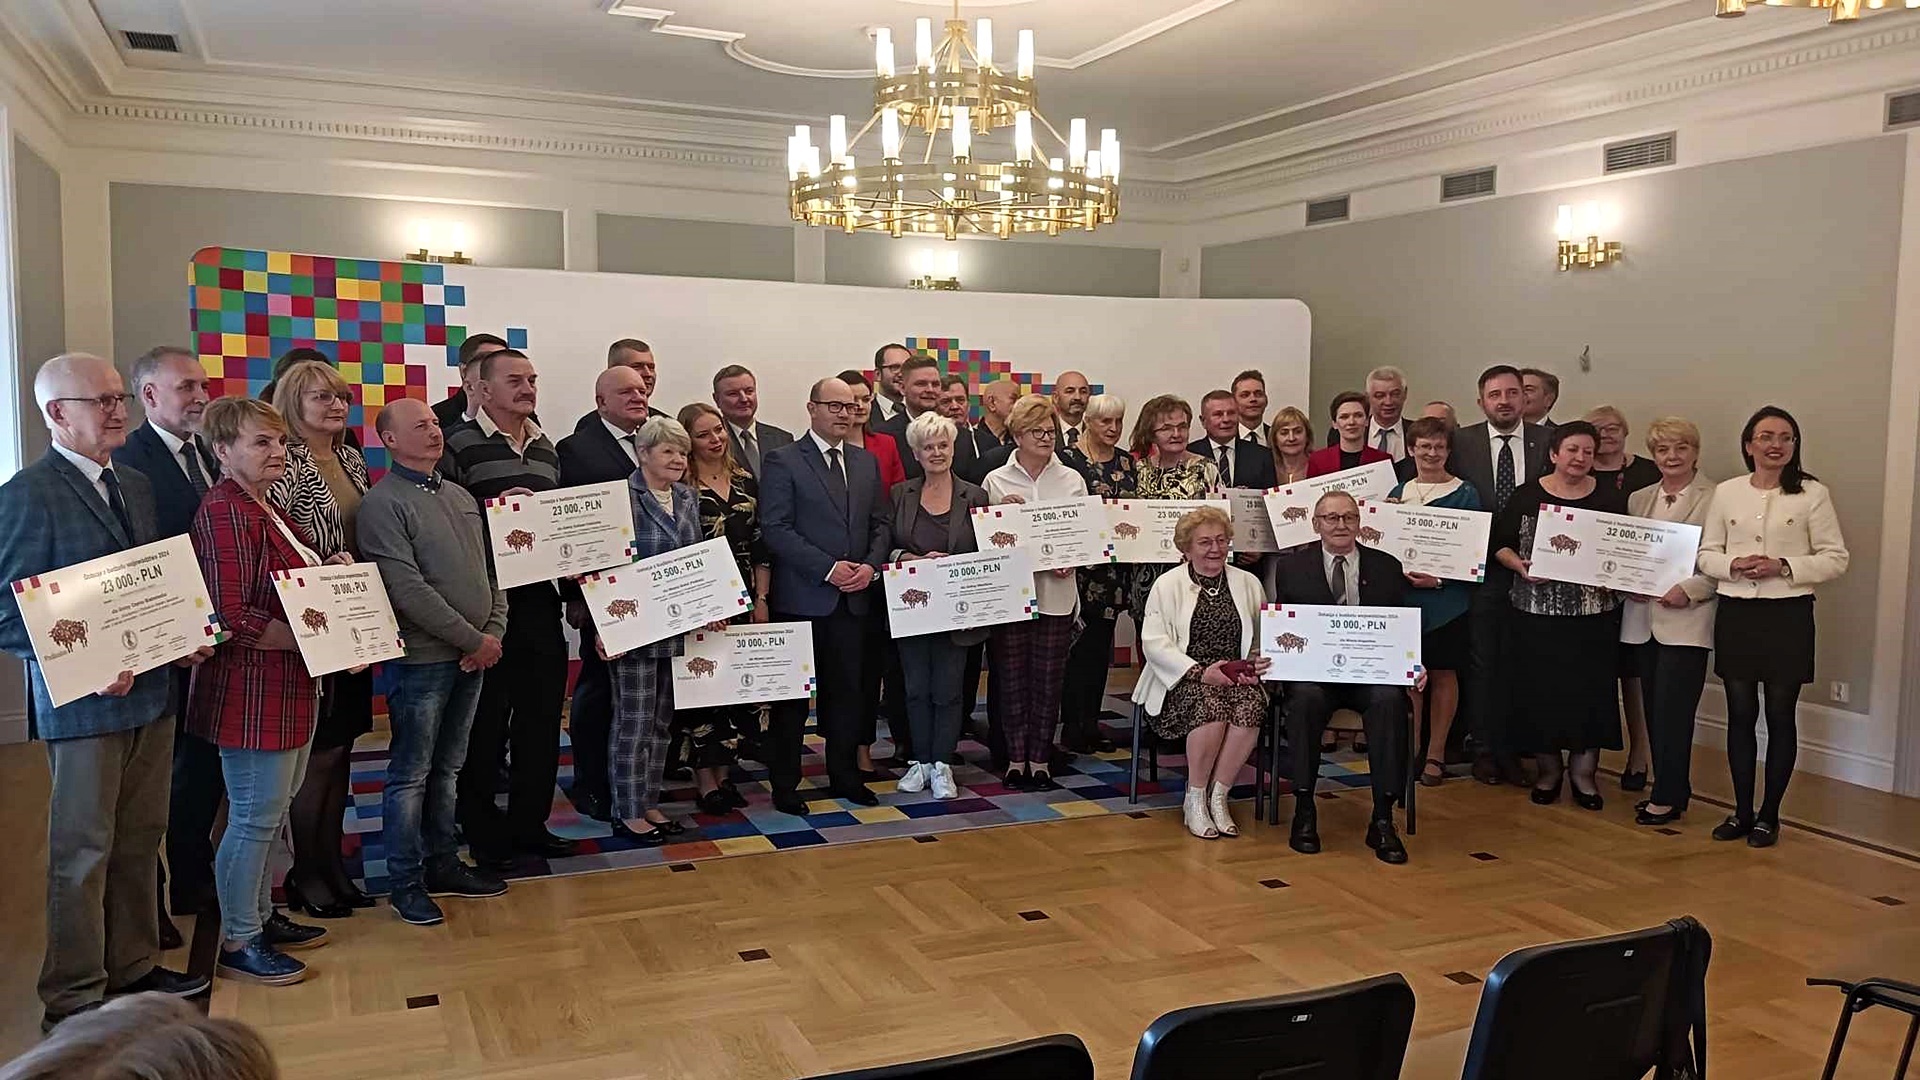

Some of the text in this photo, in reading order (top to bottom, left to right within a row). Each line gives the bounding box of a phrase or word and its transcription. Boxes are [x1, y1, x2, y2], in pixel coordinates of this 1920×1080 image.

[1352, 477, 1368, 487] PLN
[552, 506, 562, 516] 23
[586, 500, 602, 510] PLN
[1032, 514, 1042, 522] 25
[1062, 510, 1078, 519] PLN
[1406, 517, 1416, 526] 35
[1440, 520, 1458, 530] PLN
[1606, 527, 1617, 536] 32
[1644, 532, 1664, 542] PLN
[652, 570, 662, 581] 23
[685, 558, 704, 570] PLN
[949, 569, 959, 578] 20
[983, 563, 1000, 573] PLN
[101, 579, 114, 594] 23
[140, 564, 162, 581] PLN
[355, 581, 368, 592] PLN
[1330, 620, 1386, 630] 30 000,- PLN
[737, 639, 746, 648] 30
[769, 637, 784, 646] PLN
